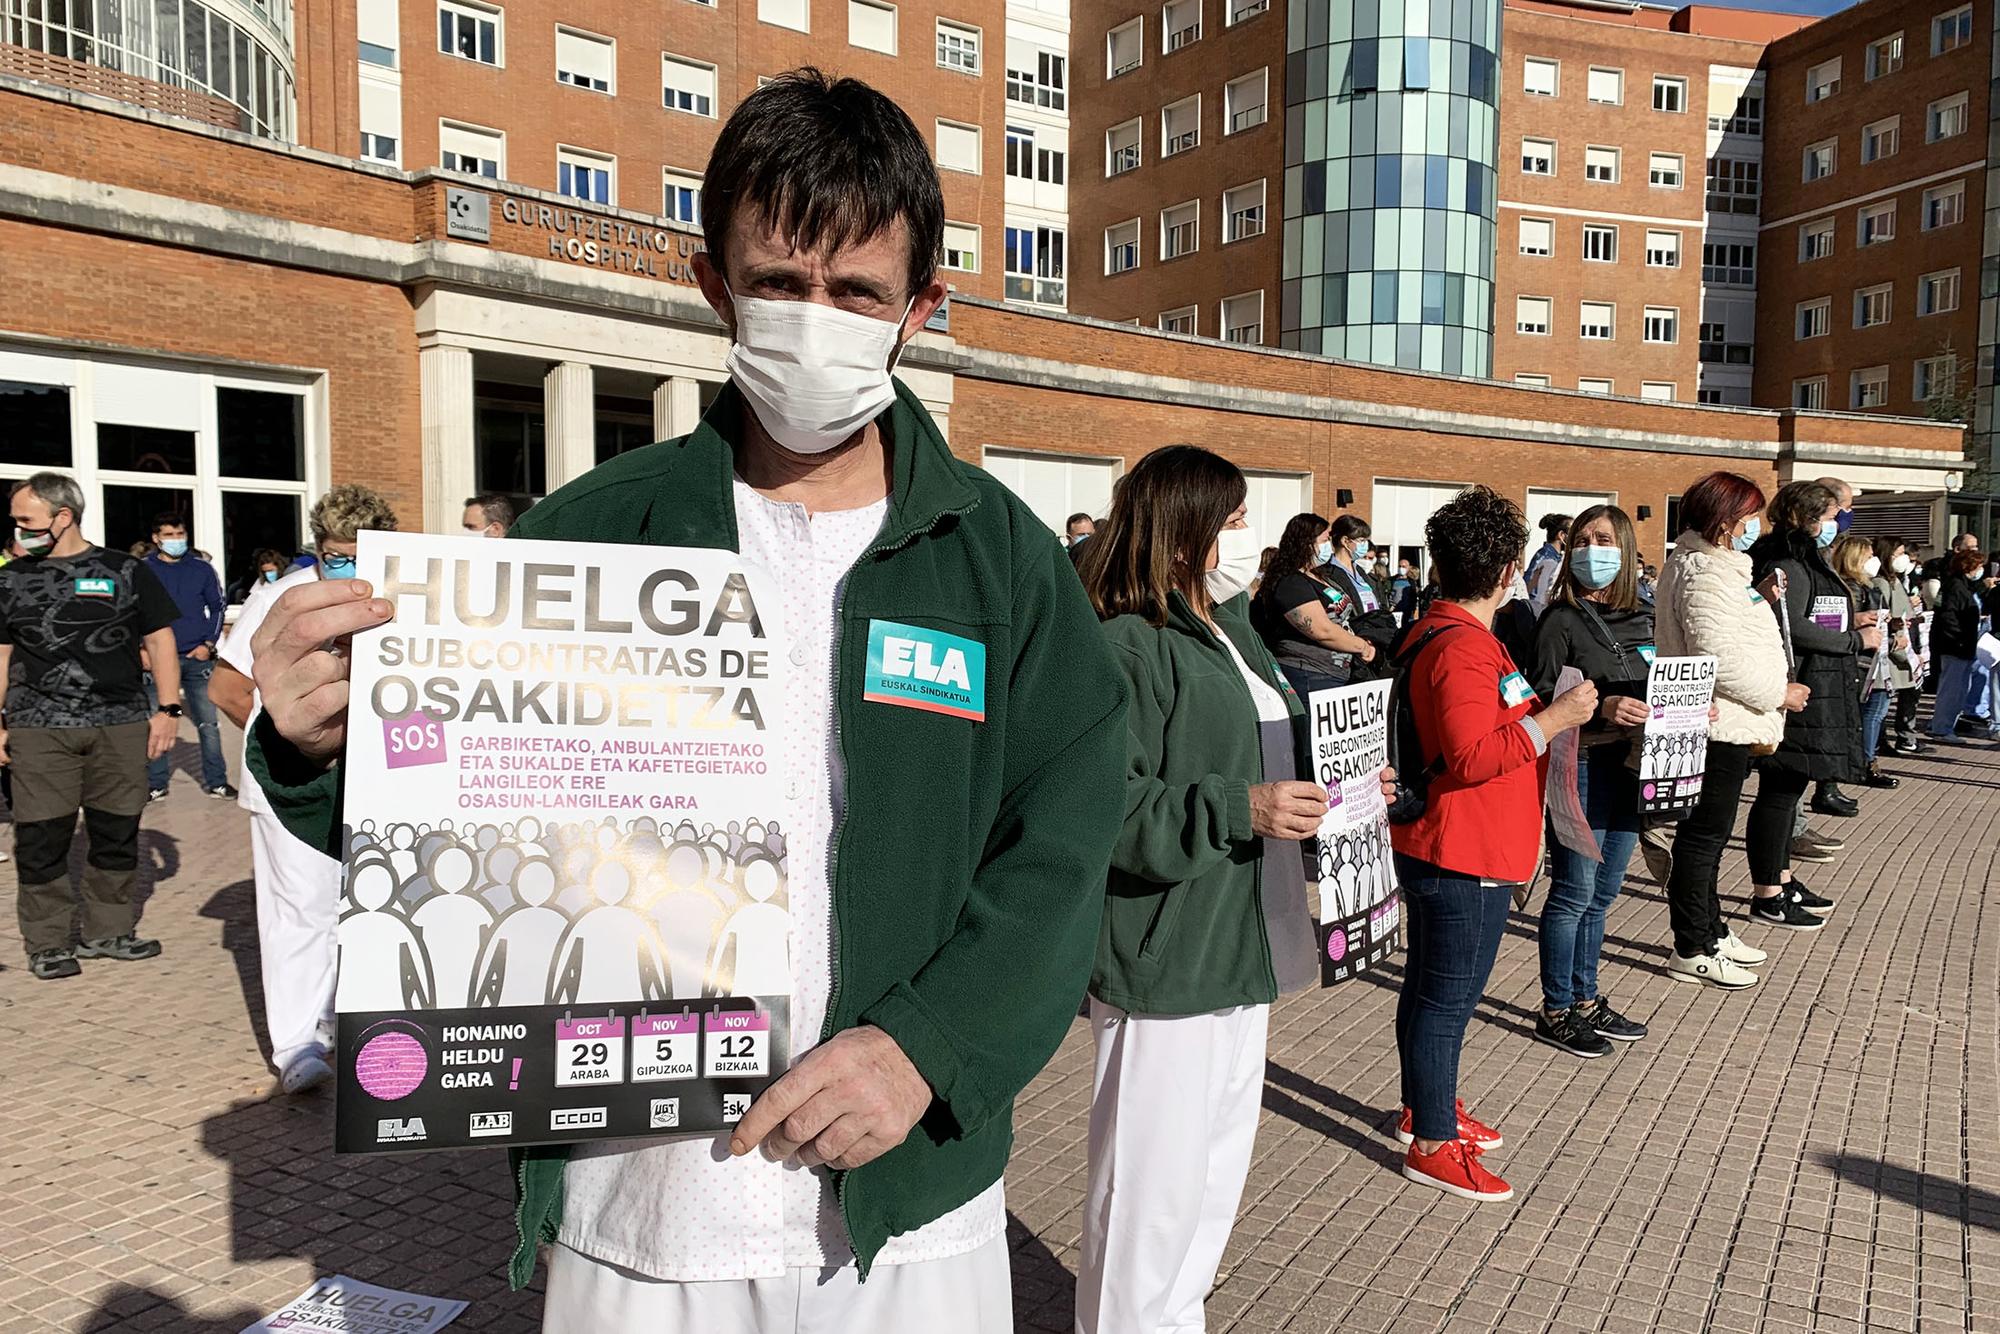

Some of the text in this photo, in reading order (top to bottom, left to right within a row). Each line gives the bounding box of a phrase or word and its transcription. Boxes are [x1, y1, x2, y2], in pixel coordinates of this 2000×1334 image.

[502, 199, 669, 252] GURUTZETAKO
[550, 235, 656, 276] HOSPITAL
[383, 555, 766, 639] HUELGA
[377, 636, 769, 679] SUBCONTRATAS DE
[882, 635, 971, 691] ELA
[1653, 661, 1714, 681] HUELGA
[881, 680, 971, 704] EUSKAL SINDIKATUA
[1651, 692, 1710, 708] OSAKIDETZA
[370, 675, 766, 730] OSAKIDETZA
[1316, 690, 1384, 738] HUELGA
[390, 723, 439, 753] SOS
[459, 736, 764, 757] GARBIKETAKO, ANBULANTZIETAKO
[1319, 729, 1378, 759] SUBCONTRATAS
[459, 756, 767, 775] ETA SUKALDE ETA KAFETEGIETAKO
[1321, 745, 1385, 786] OSAKIDETZA
[458, 774, 606, 789] LANGILEOK ERE
[458, 794, 698, 810] OSASUN-LANGILEAK GARA
[1329, 783, 1340, 801] SOS
[442, 1023, 527, 1042] HONAINO
[577, 1024, 602, 1035] OCT
[652, 1020, 677, 1032] NOV
[724, 1017, 750, 1028] NOV
[571, 1043, 609, 1066] 29
[655, 1039, 673, 1061] 5
[719, 1035, 755, 1058] 12
[441, 1049, 504, 1066] HELDU
[714, 1060, 759, 1073] BIZKAIA
[441, 1072, 494, 1089] GARA
[569, 1068, 610, 1080] ARABA
[636, 1064, 694, 1077] GIPUZKOA
[554, 1111, 603, 1127] CCOO
[655, 1103, 674, 1115] UGT
[377, 1117, 427, 1138] ELA
[471, 1114, 510, 1131] LAB
[306, 1286, 436, 1323] HUELGA
[293, 1302, 425, 1332] SUBCONTRATAS DE
